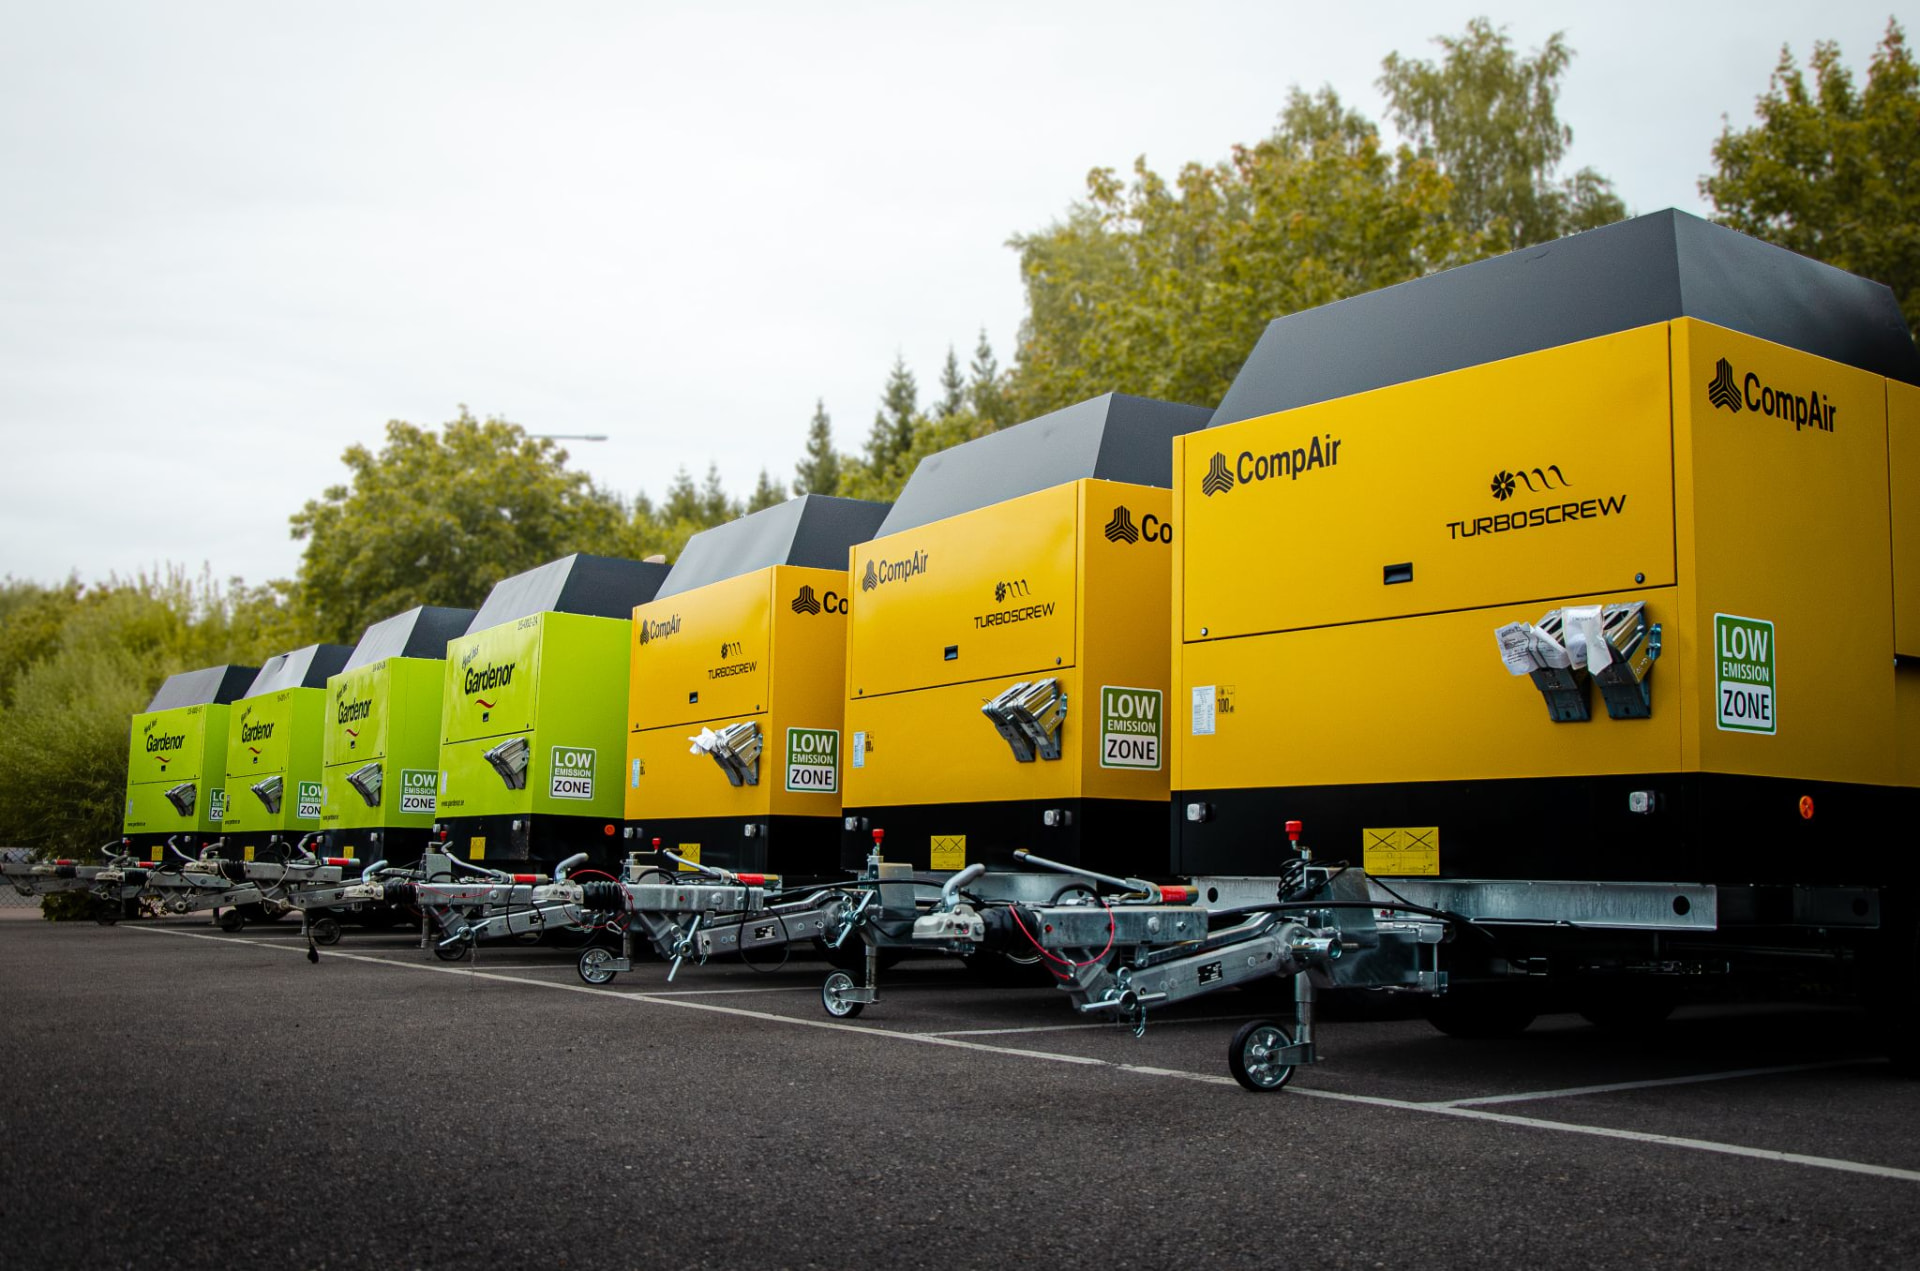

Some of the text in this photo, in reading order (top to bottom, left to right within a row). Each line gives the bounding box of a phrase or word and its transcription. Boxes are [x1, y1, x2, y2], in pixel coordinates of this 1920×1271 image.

[1744, 372, 1837, 432] CompAir
[1237, 434, 1342, 485] CompAir
[1446, 494, 1627, 540] TURBOSCREW
[878, 550, 928, 585] CompAir
[974, 602, 1056, 629] TURBOSCREW
[650, 614, 681, 640] CompAir
[1721, 624, 1768, 662] LOW
[464, 661, 516, 696] Gardenor
[708, 661, 757, 680] TURBOSCREW
[1722, 661, 1769, 682] EMISSION
[337, 697, 373, 725] Gardenor
[1107, 693, 1156, 720] LOW
[1723, 689, 1770, 721] ZONE
[241, 719, 275, 744] Gardenor
[1107, 719, 1156, 734] EMISSION
[146, 731, 186, 753] Gardenor
[792, 733, 834, 754] LOW
[1107, 738, 1155, 761] ZONE
[555, 751, 592, 769] LOW
[792, 753, 833, 765] EMISSION
[404, 773, 437, 788] LOW
[554, 767, 591, 778] EMISSION
[791, 768, 833, 786] ZONE
[404, 786, 436, 795] EMISSION
[553, 780, 591, 794] ZONE
[403, 797, 436, 809] ZONE
